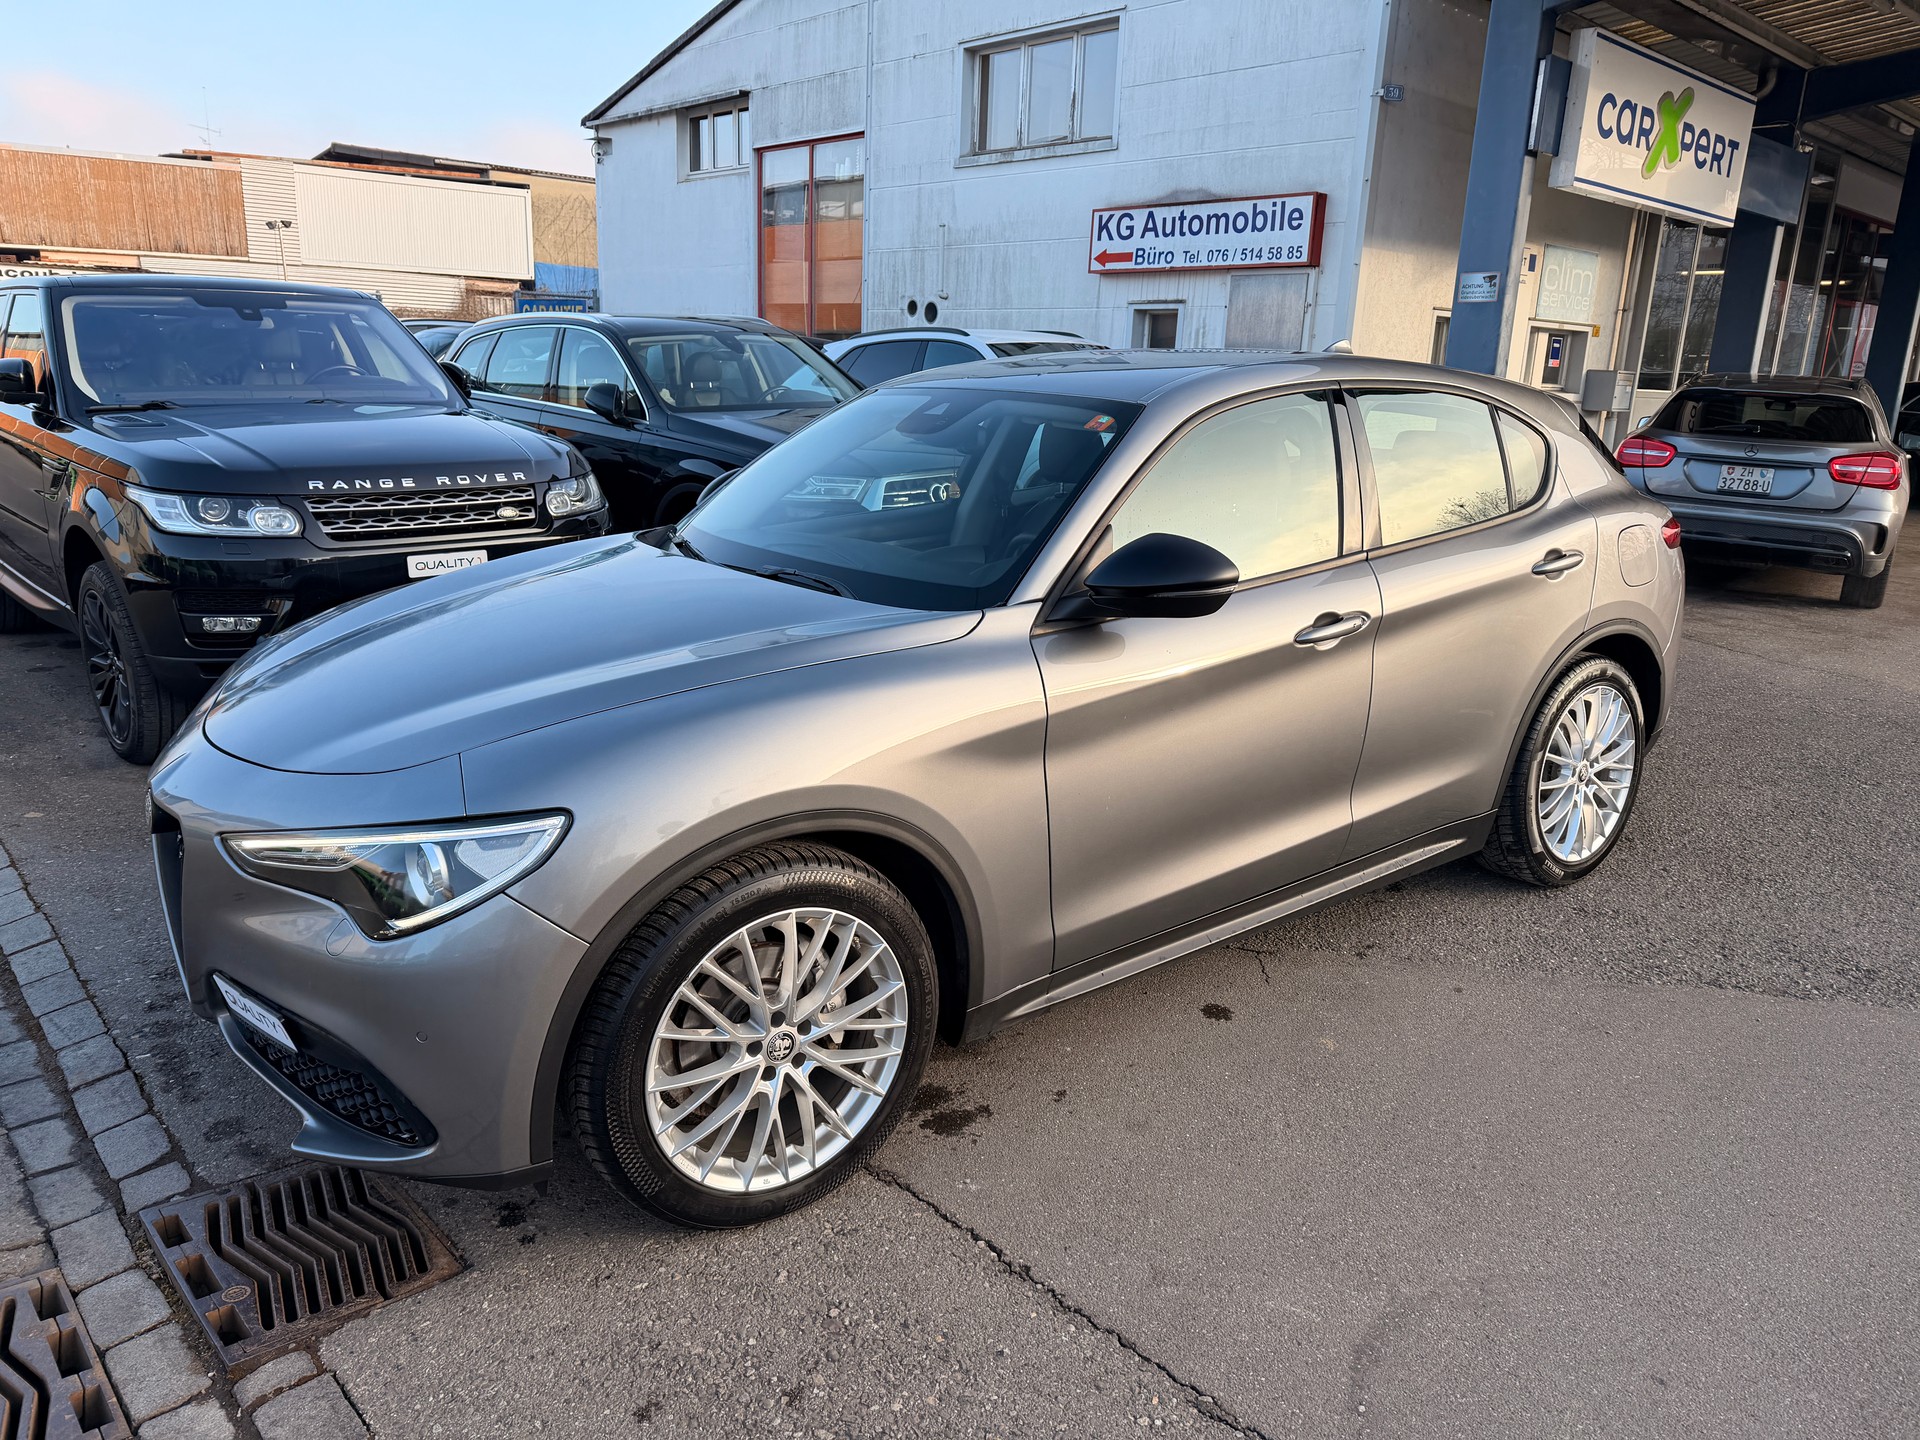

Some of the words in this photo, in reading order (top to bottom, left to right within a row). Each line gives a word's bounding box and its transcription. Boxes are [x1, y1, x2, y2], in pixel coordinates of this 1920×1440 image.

[1096, 213, 1135, 241] KG
[1140, 201, 1304, 239] Automobile
[1134, 247, 1175, 266] Büro
[1182, 249, 1202, 264] Tel.
[1207, 248, 1229, 262] 076
[1231, 248, 1238, 262] /
[1240, 247, 1263, 261] 514
[1266, 246, 1284, 260] 58
[1286, 245, 1304, 260] 85
[1544, 256, 1593, 295] clim
[1542, 291, 1590, 311] service
[308, 477, 416, 490] RANGE
[435, 471, 527, 486] ROVER
[1740, 467, 1754, 478] ZH
[415, 557, 475, 571] QUALITY
[224, 990, 279, 1034] QUALITY
